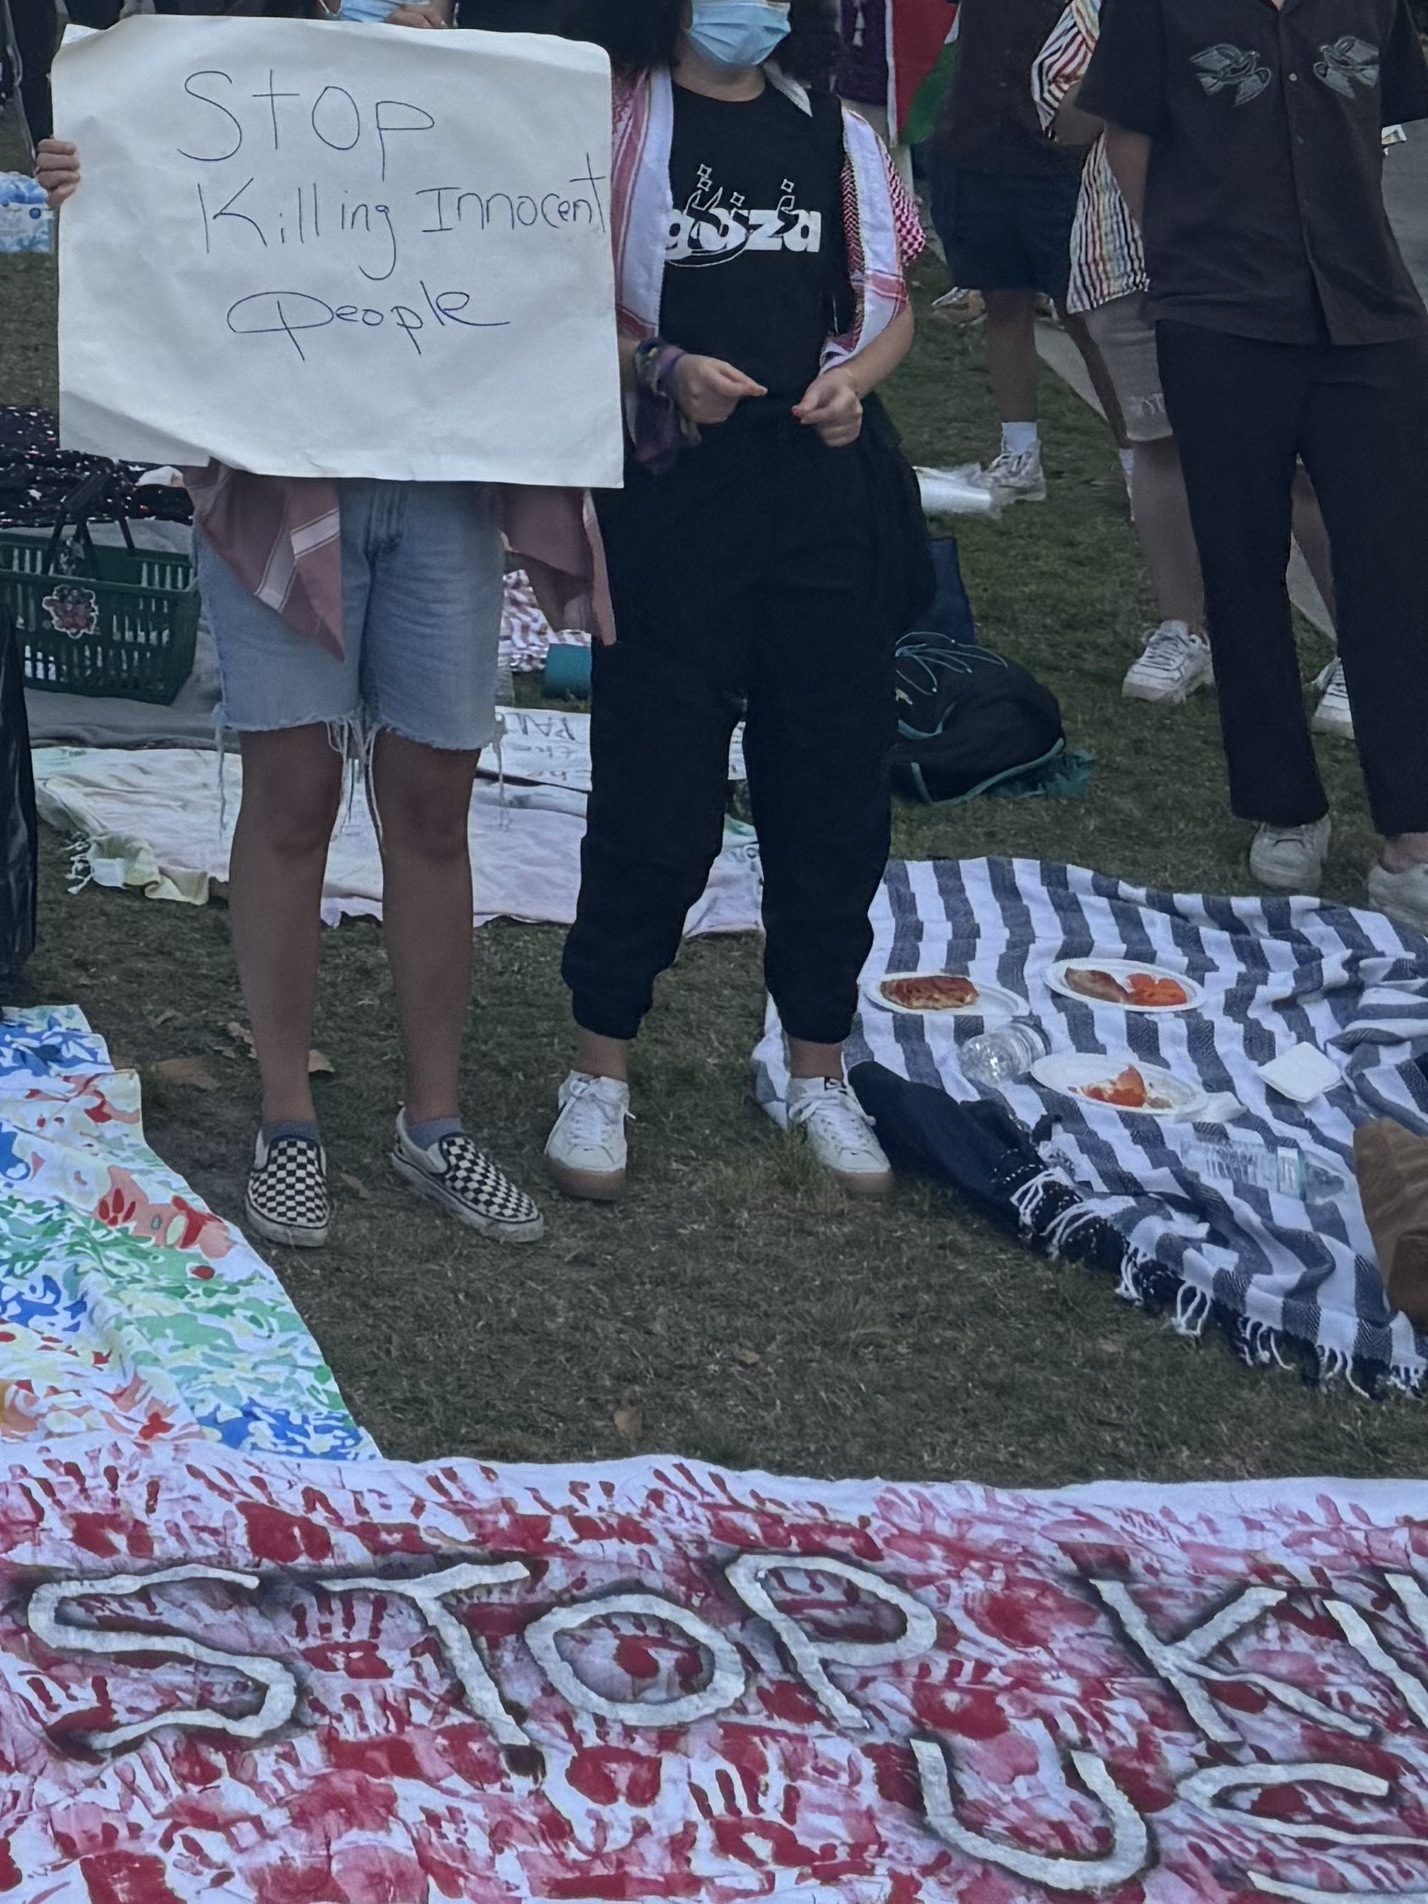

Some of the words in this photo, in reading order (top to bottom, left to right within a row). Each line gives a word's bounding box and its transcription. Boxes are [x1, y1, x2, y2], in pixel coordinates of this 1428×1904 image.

[197, 178, 396, 281] Killing
[226, 280, 510, 362] People
[26, 1550, 938, 1755] STOP
